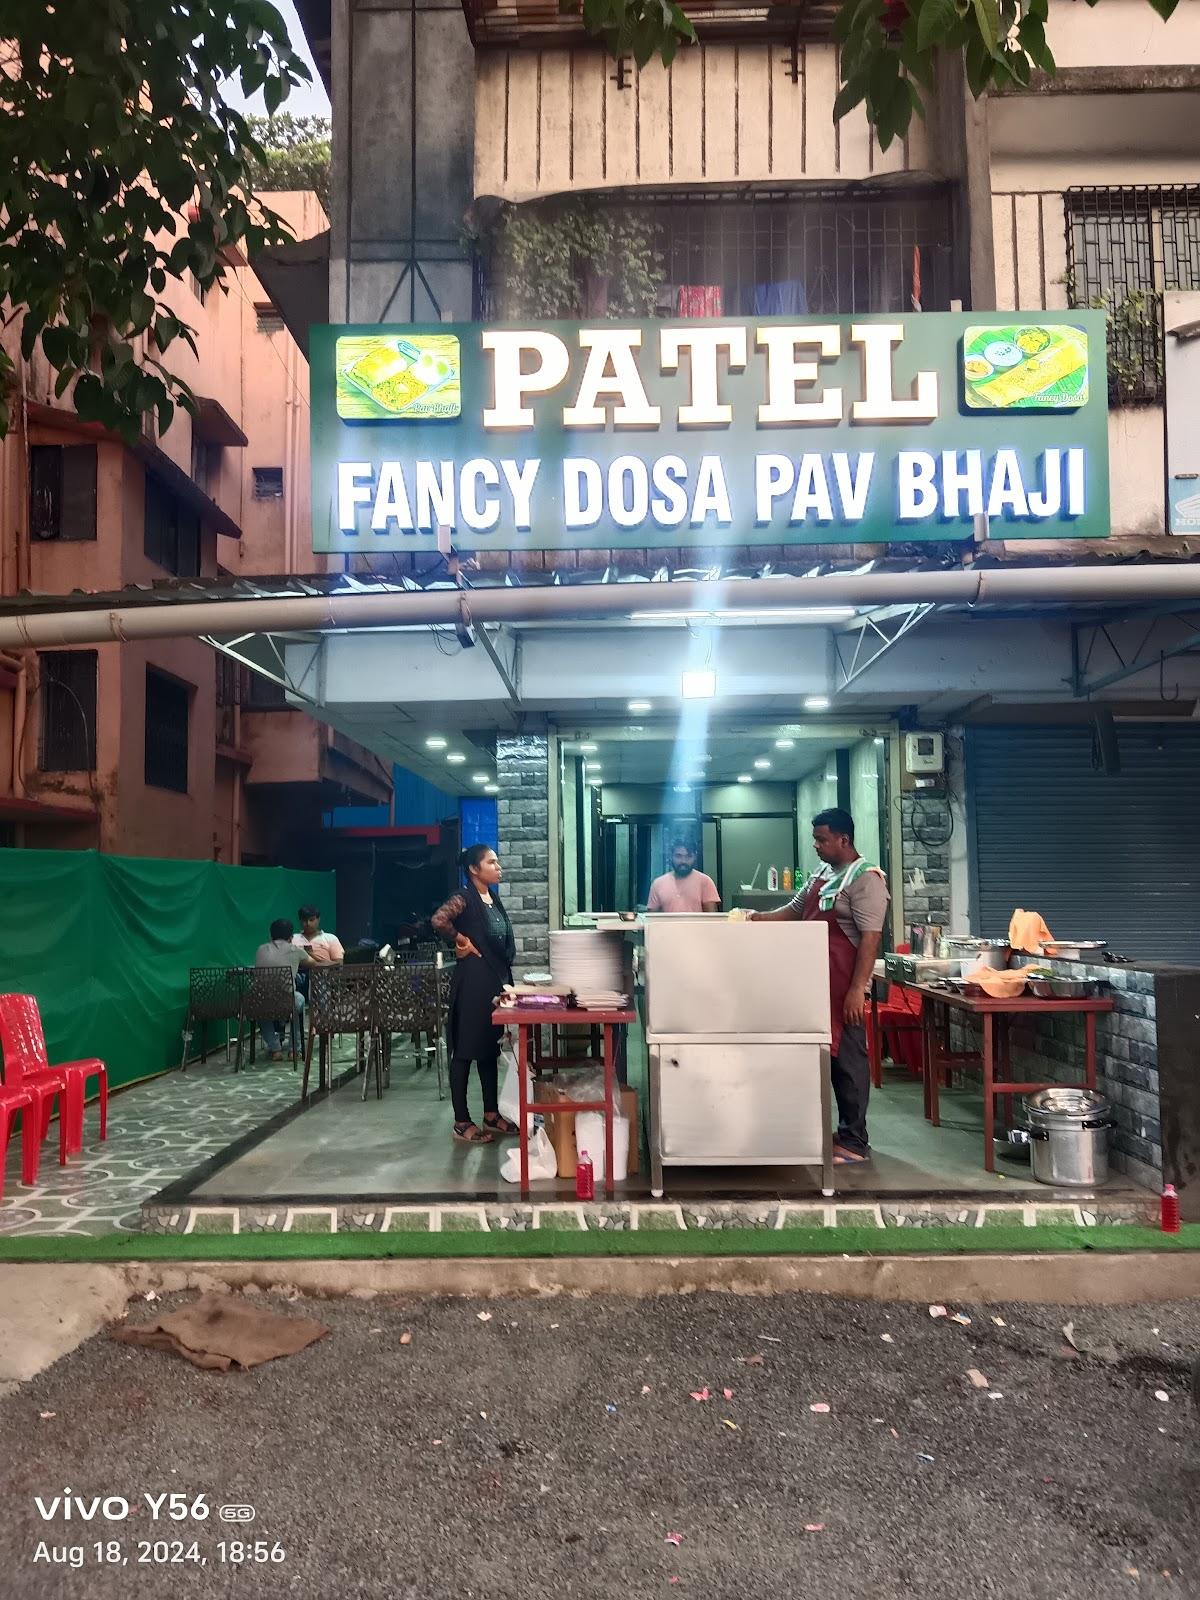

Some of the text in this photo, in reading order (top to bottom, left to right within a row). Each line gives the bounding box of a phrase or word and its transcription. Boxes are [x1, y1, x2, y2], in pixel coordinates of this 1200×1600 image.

[482, 324, 938, 427] PATEL
[1033, 392, 1085, 403] Fancy Dosa
[337, 448, 1085, 531] FANCY DOSA PAV BHAJI
